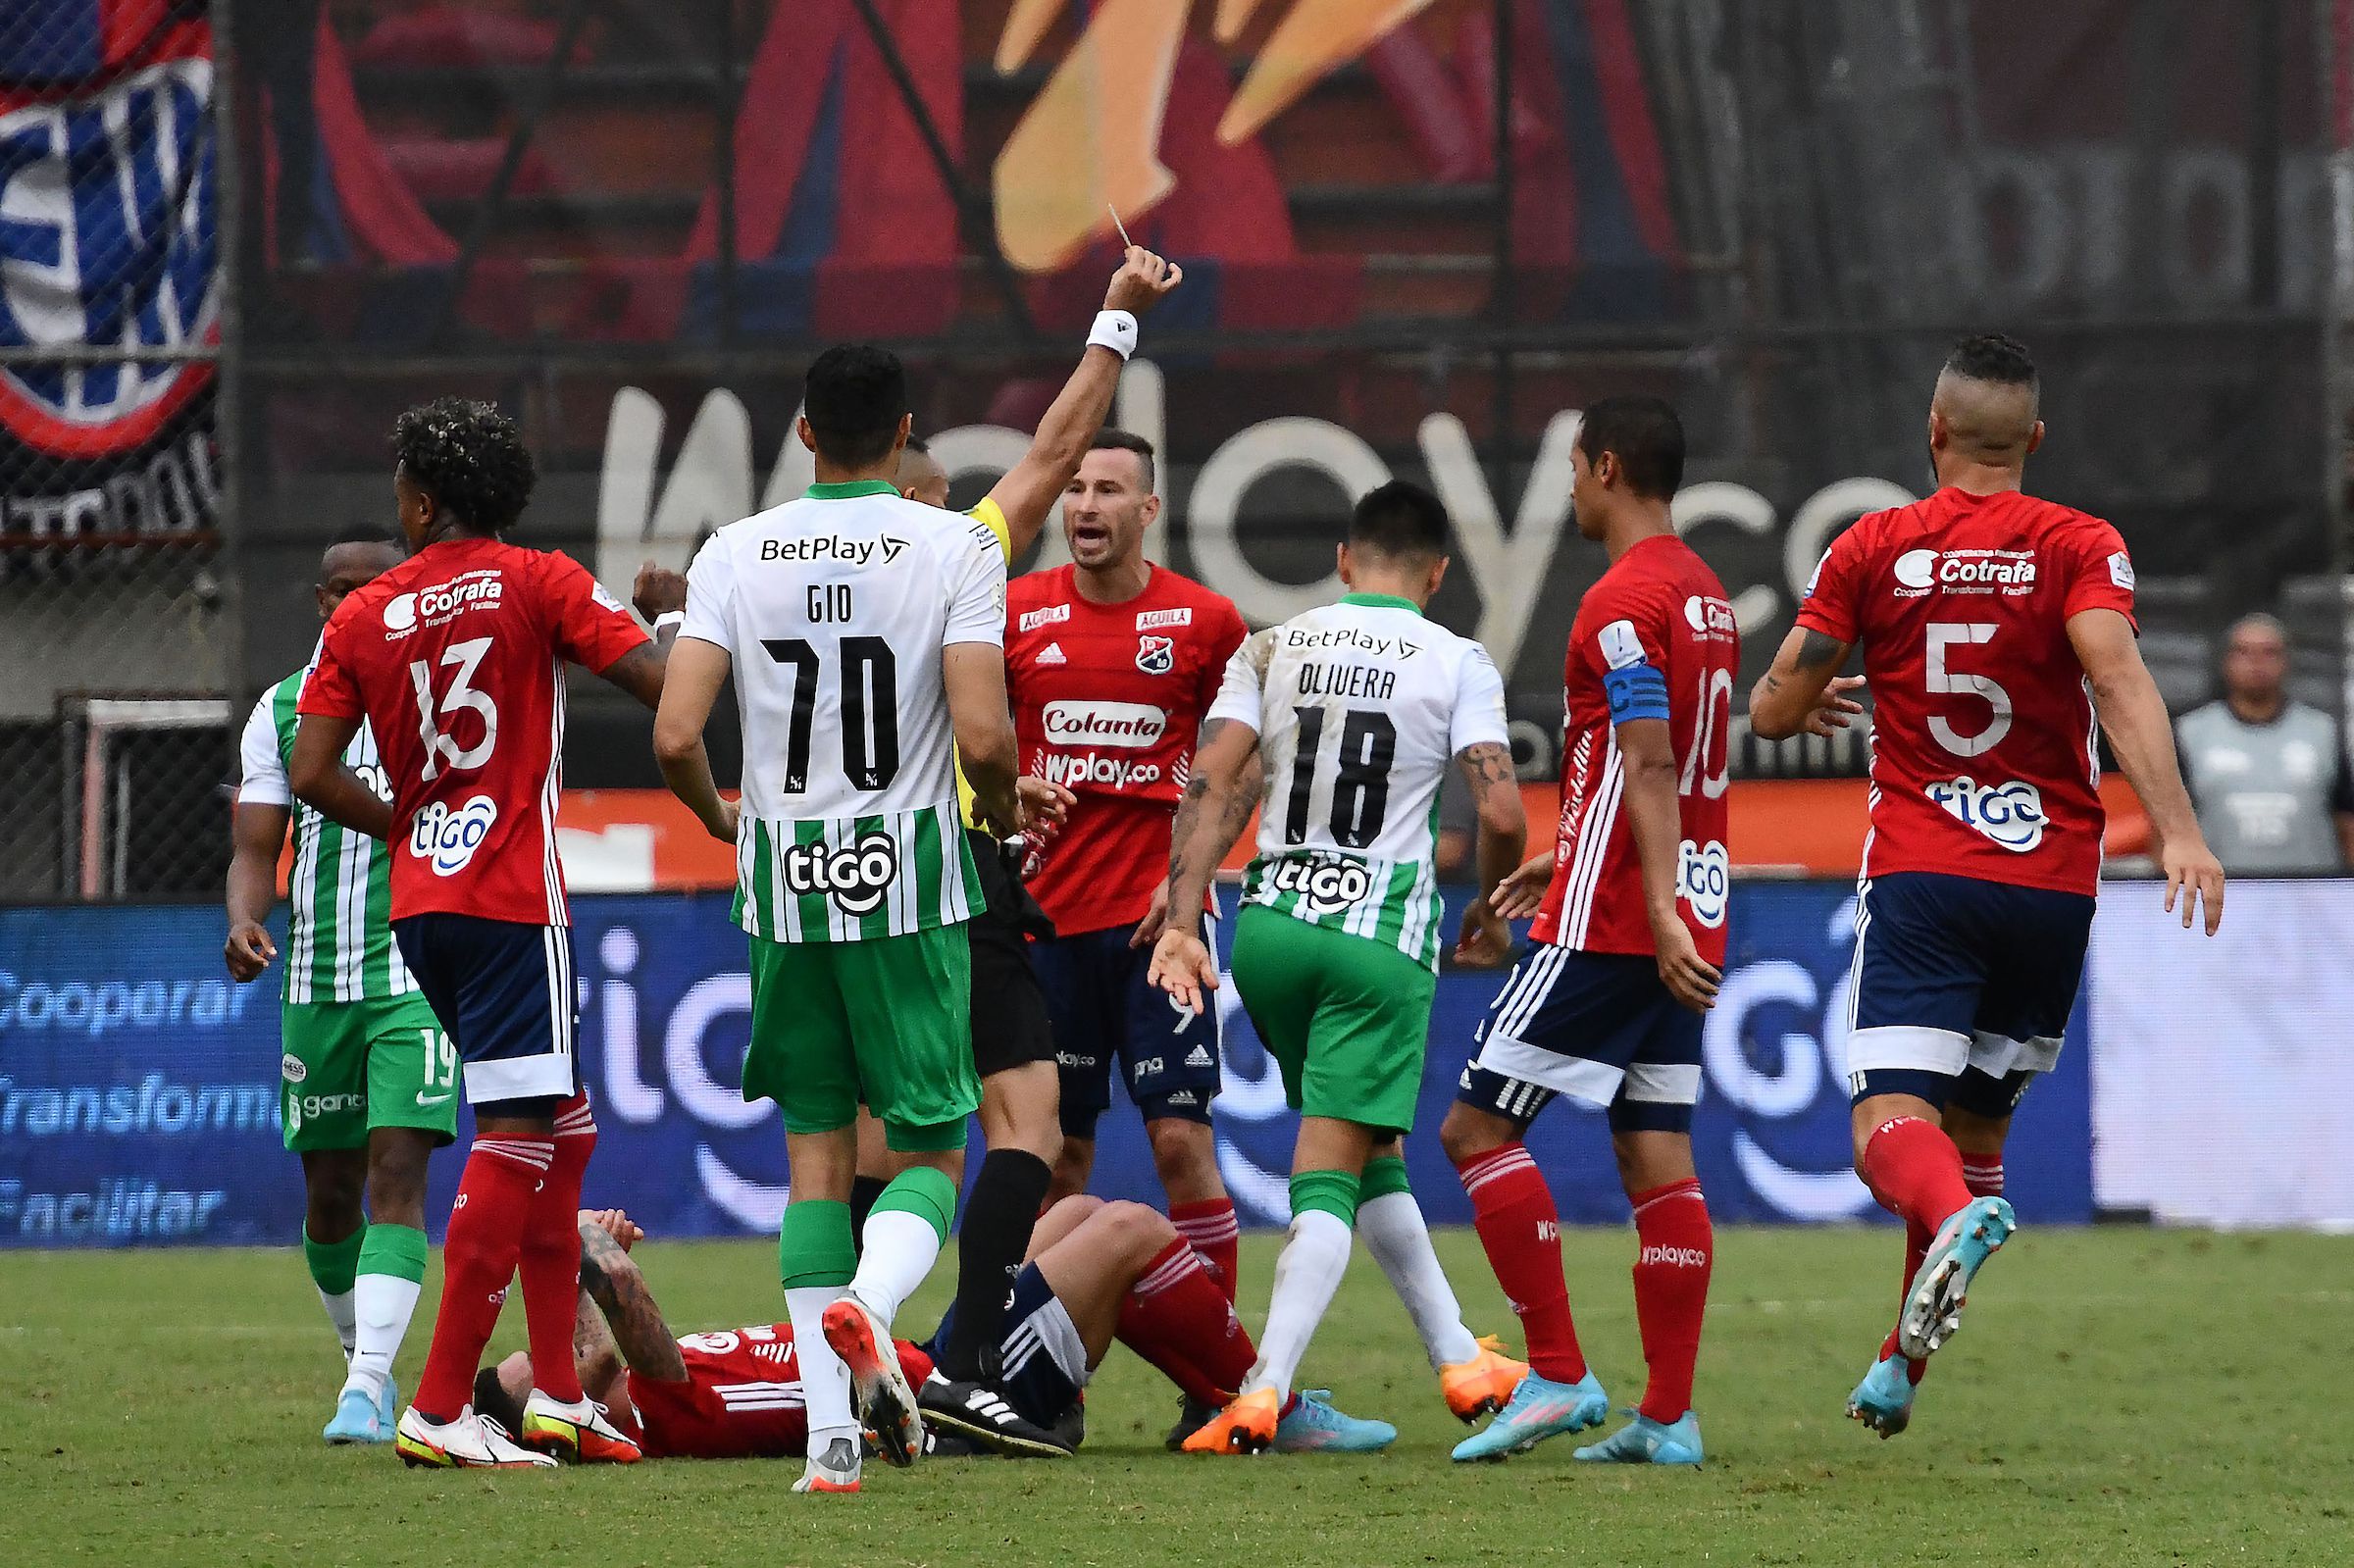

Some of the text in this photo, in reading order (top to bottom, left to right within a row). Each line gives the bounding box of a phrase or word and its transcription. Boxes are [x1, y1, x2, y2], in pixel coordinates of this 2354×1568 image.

[761, 535, 874, 565] BetPlay
[1940, 559, 2036, 582] Cotrafa
[420, 578, 502, 616] Cotrafa
[807, 583, 852, 624] GIO
[1288, 628, 1391, 655] BetPlay
[410, 636, 497, 782] 13
[759, 635, 900, 793] 70
[1925, 623, 2013, 758] 5
[1046, 709, 1161, 736] Colanta
[1678, 667, 1732, 800] 10
[1045, 751, 1160, 791] Wplay.co
[1285, 705, 1397, 850] 18
[415, 801, 491, 851] tigo
[788, 835, 893, 890] tigo
[1275, 857, 1369, 902] tigo
[1676, 847, 1726, 896] igo
[420, 1029, 457, 1088] 19
